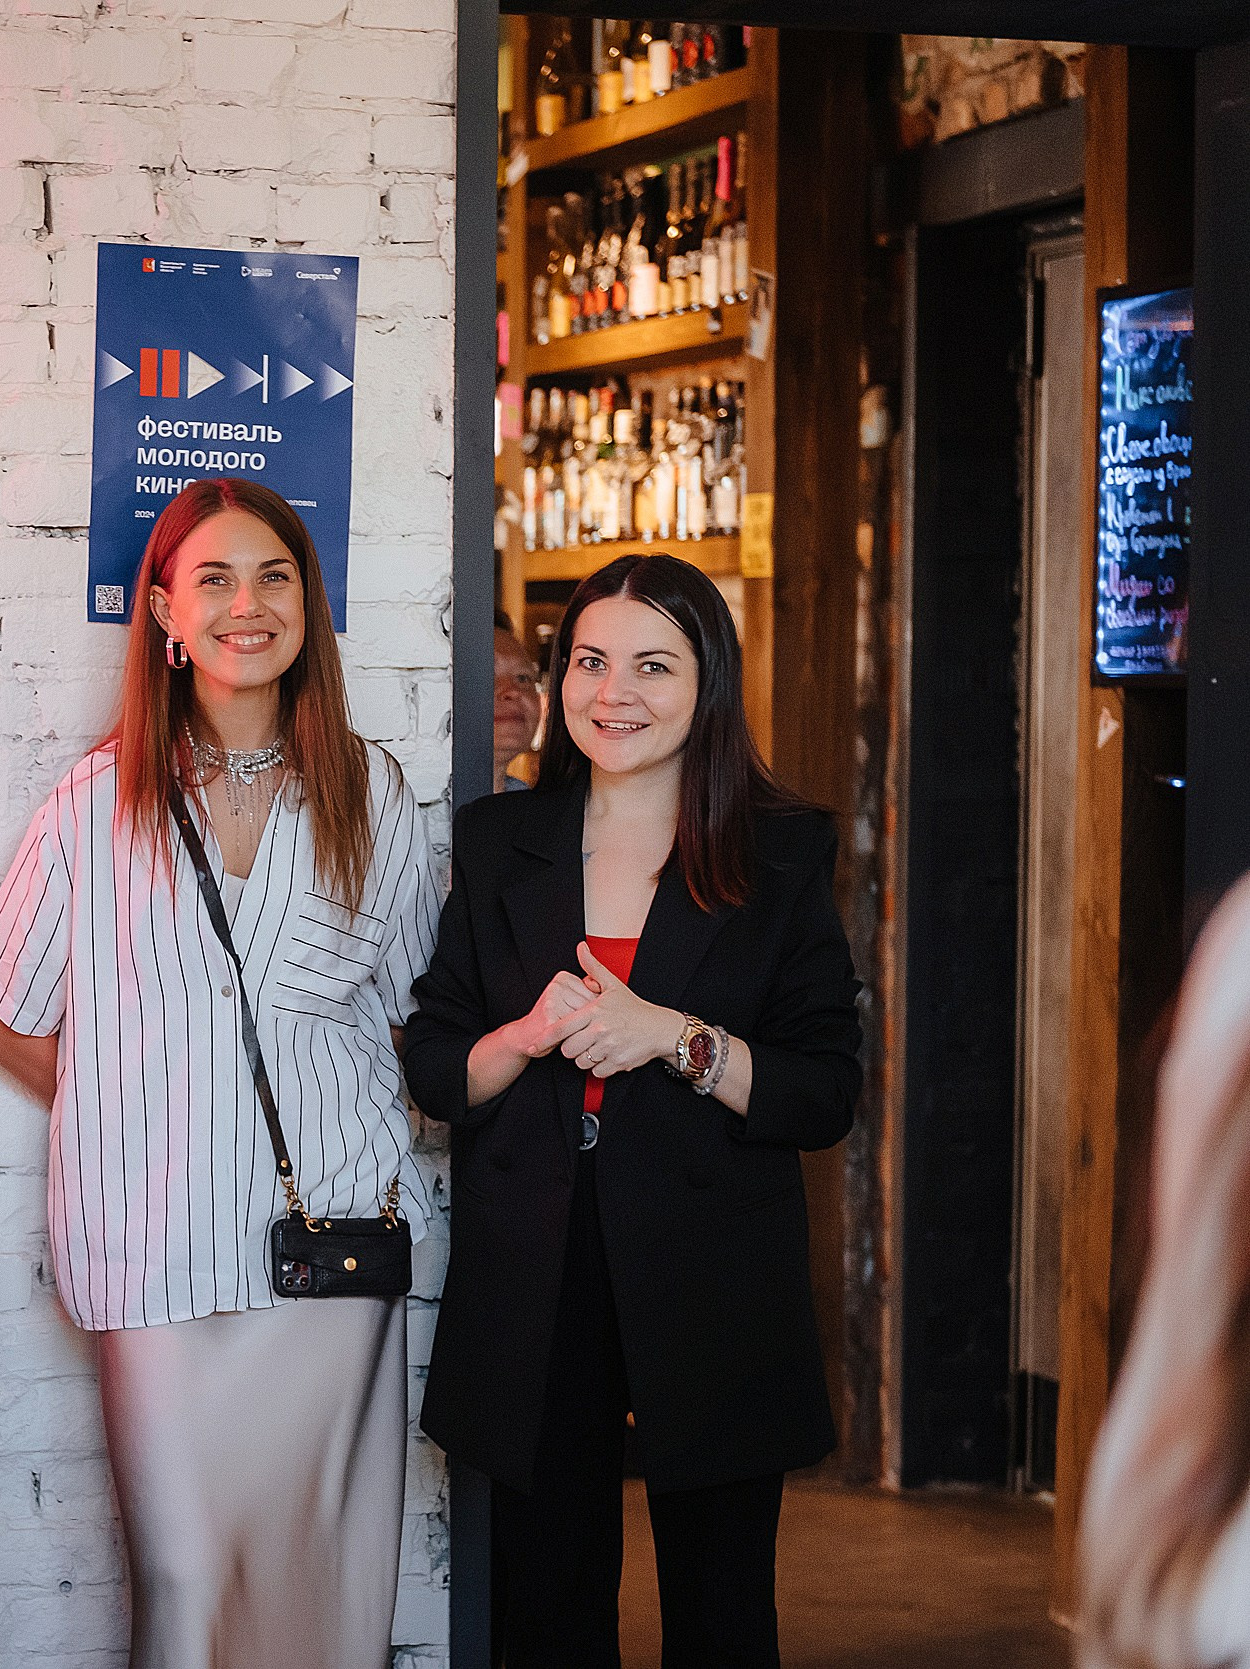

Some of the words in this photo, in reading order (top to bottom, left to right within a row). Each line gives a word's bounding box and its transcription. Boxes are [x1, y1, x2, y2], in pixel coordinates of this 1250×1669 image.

[137, 414, 282, 443] фестиваль
[136, 447, 266, 471] молодого
[134, 510, 155, 518] 2024
